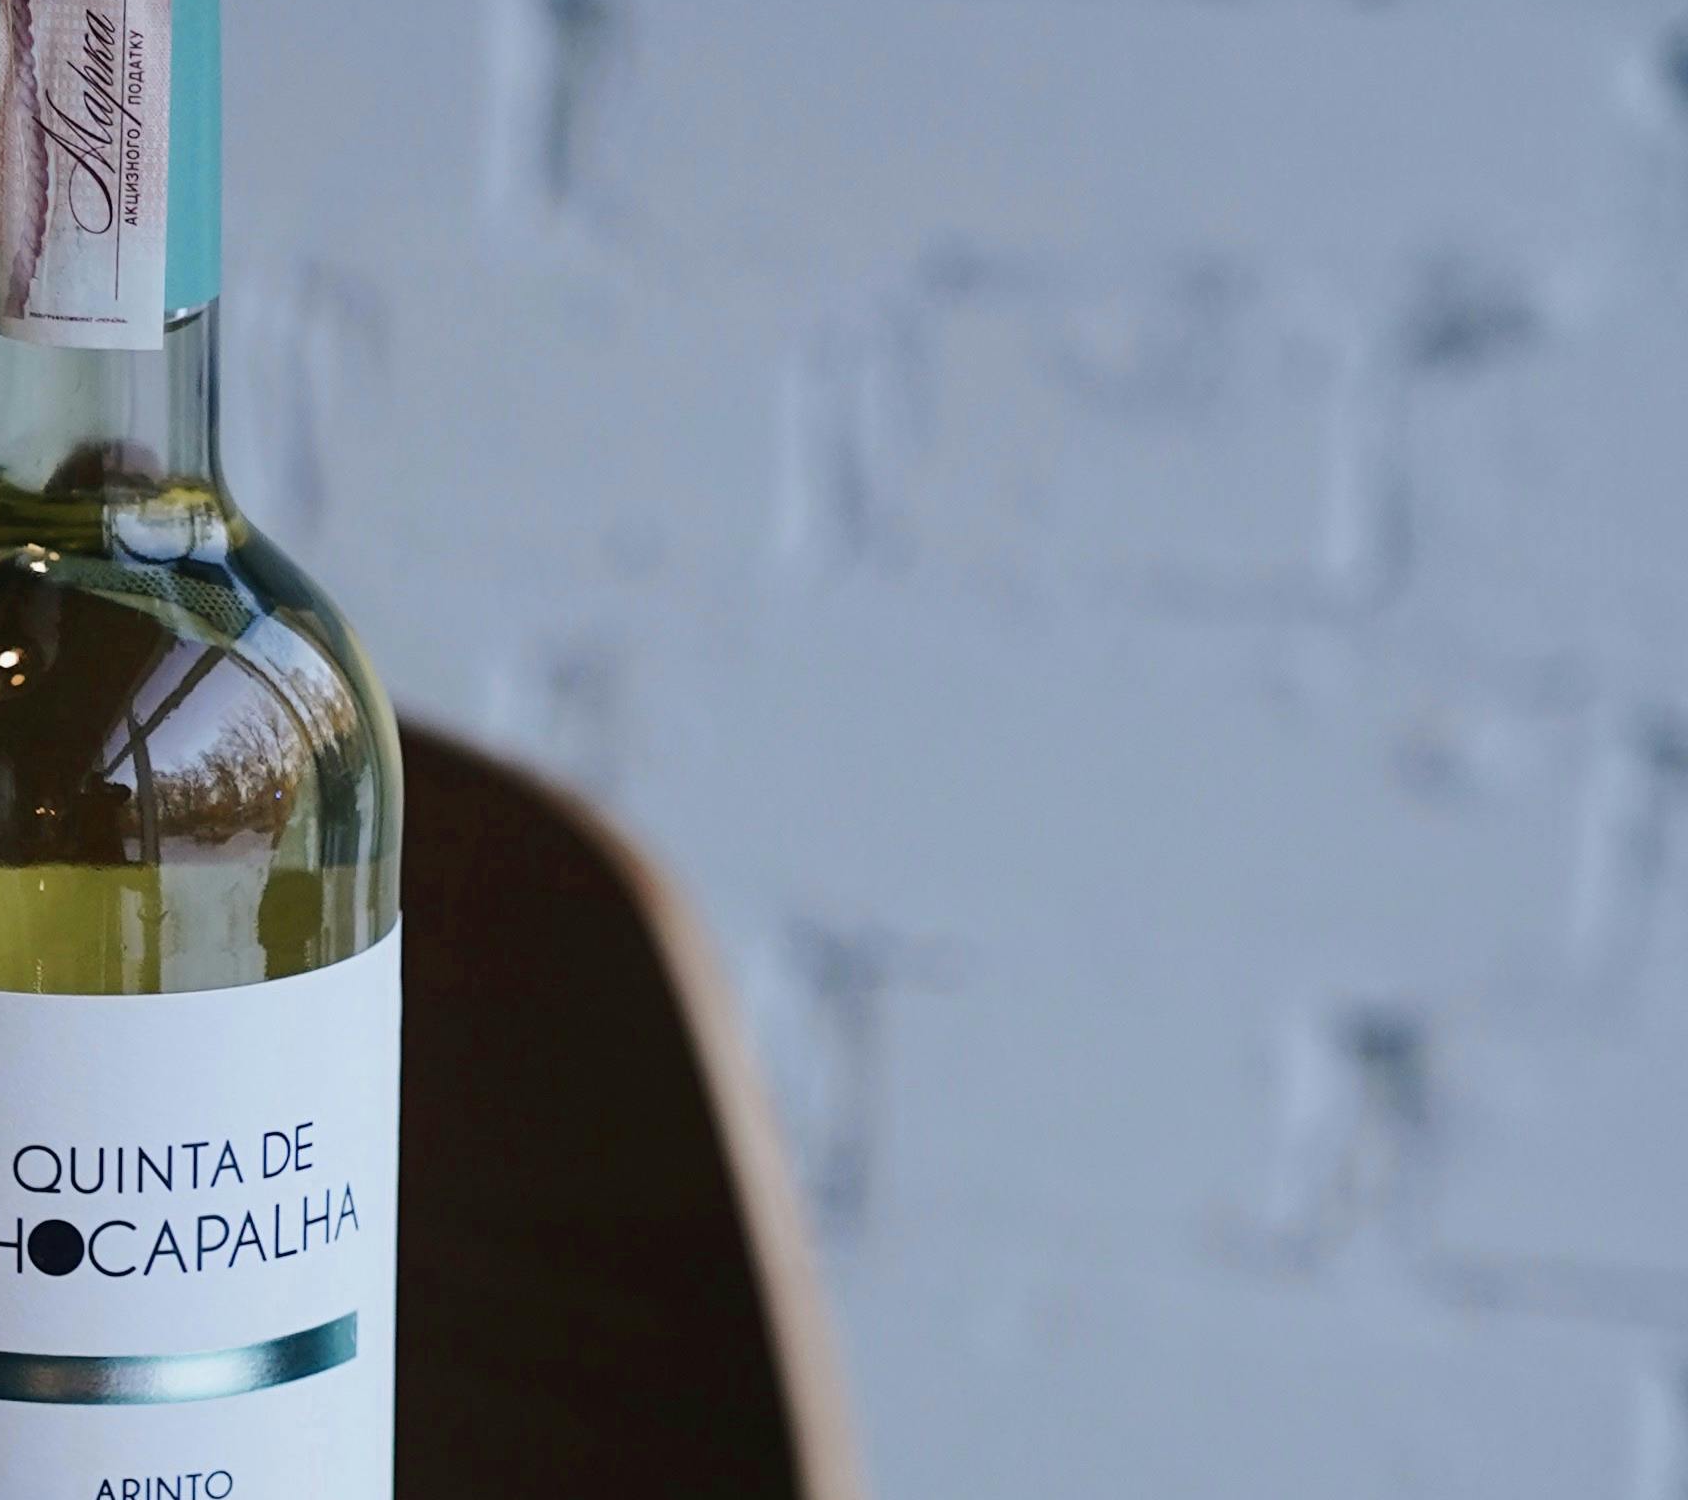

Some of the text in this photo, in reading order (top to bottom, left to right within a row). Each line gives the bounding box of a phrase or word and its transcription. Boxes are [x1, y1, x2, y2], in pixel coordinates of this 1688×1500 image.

[31, 8, 142, 235] Марка
[123, 29, 145, 227] АКЦИЗНОГО ПОДАТКУ
[12, 1121, 314, 1195] QUINTA DE
